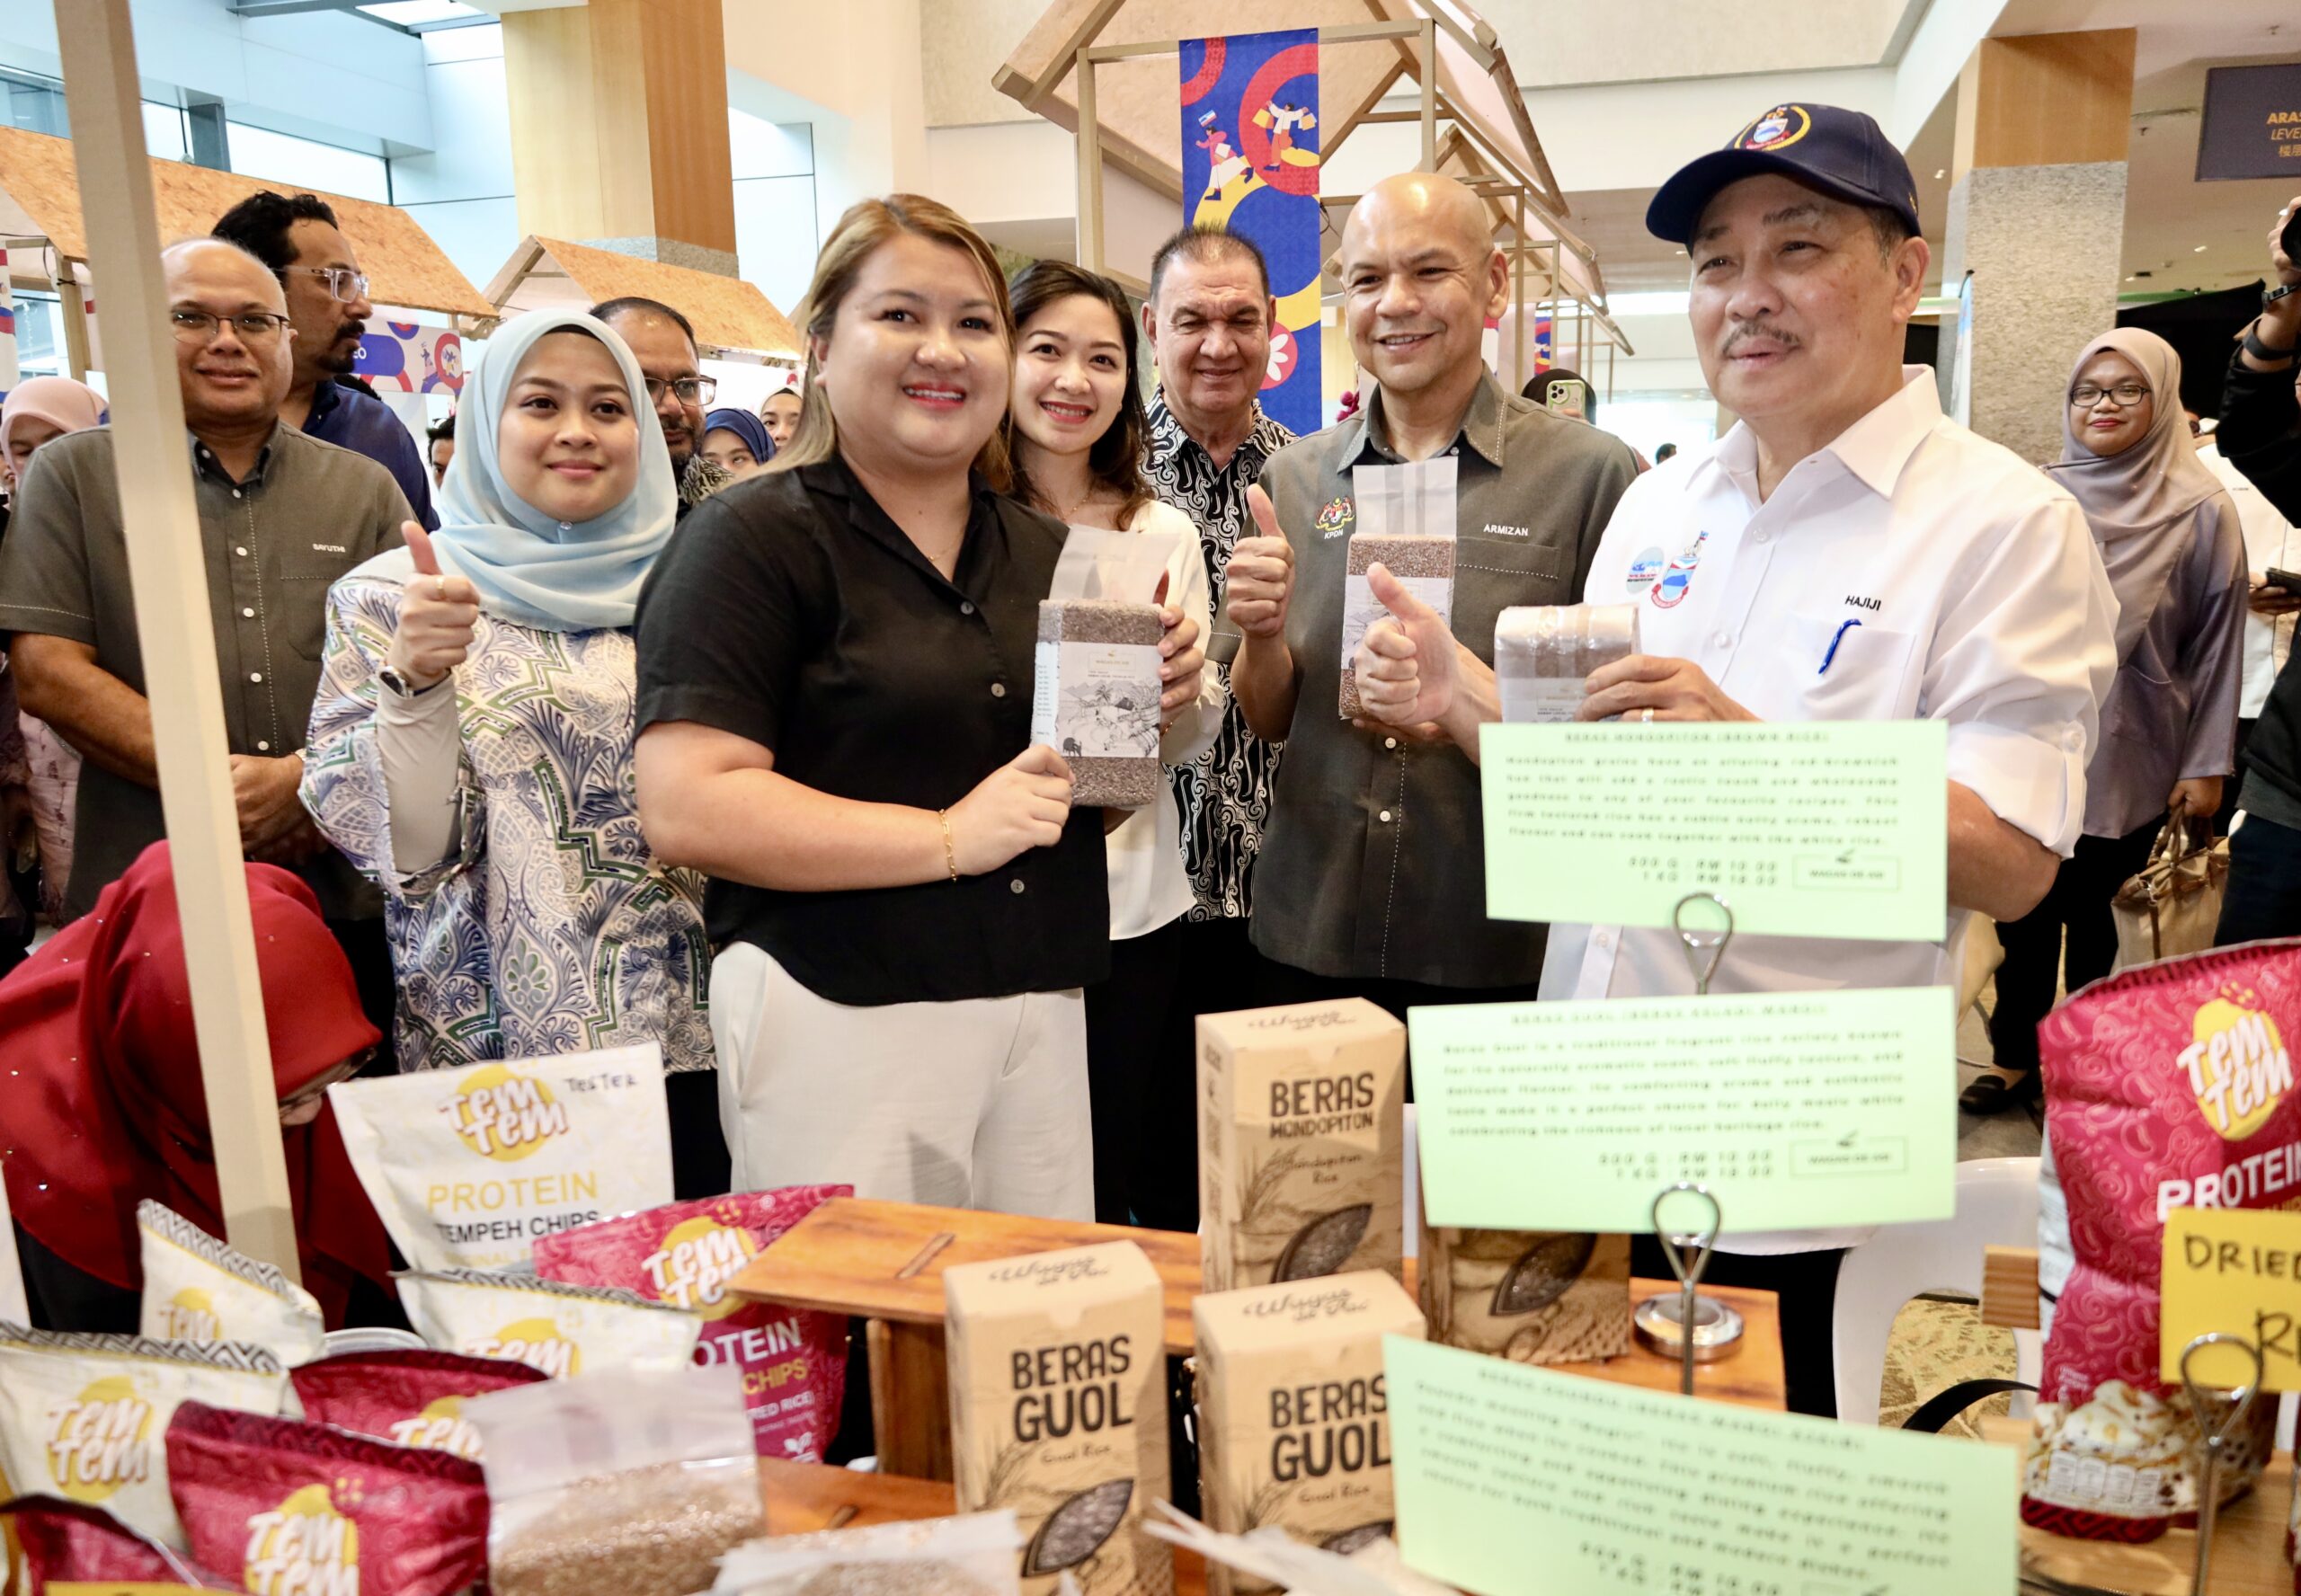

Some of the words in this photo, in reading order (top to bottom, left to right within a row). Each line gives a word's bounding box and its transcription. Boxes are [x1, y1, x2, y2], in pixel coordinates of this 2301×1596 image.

[1324, 528, 1344, 539] KPDN
[1483, 523, 1528, 536] ARMIZAN
[1844, 594, 1882, 612] HAJIJI
[1269, 1071, 1375, 1119] BERAS
[1269, 1111, 1374, 1139] MONDOPITON
[426, 1170, 600, 1213] PROTEIN
[436, 1219, 522, 1243] TEMPEH
[689, 1317, 803, 1369] OTEIN
[1011, 1334, 1132, 1391] BERAS
[742, 1358, 807, 1395] CHIPS
[1014, 1381, 1134, 1443] GUOL
[1270, 1374, 1387, 1429] BERAS
[1271, 1420, 1391, 1483] GUOL
